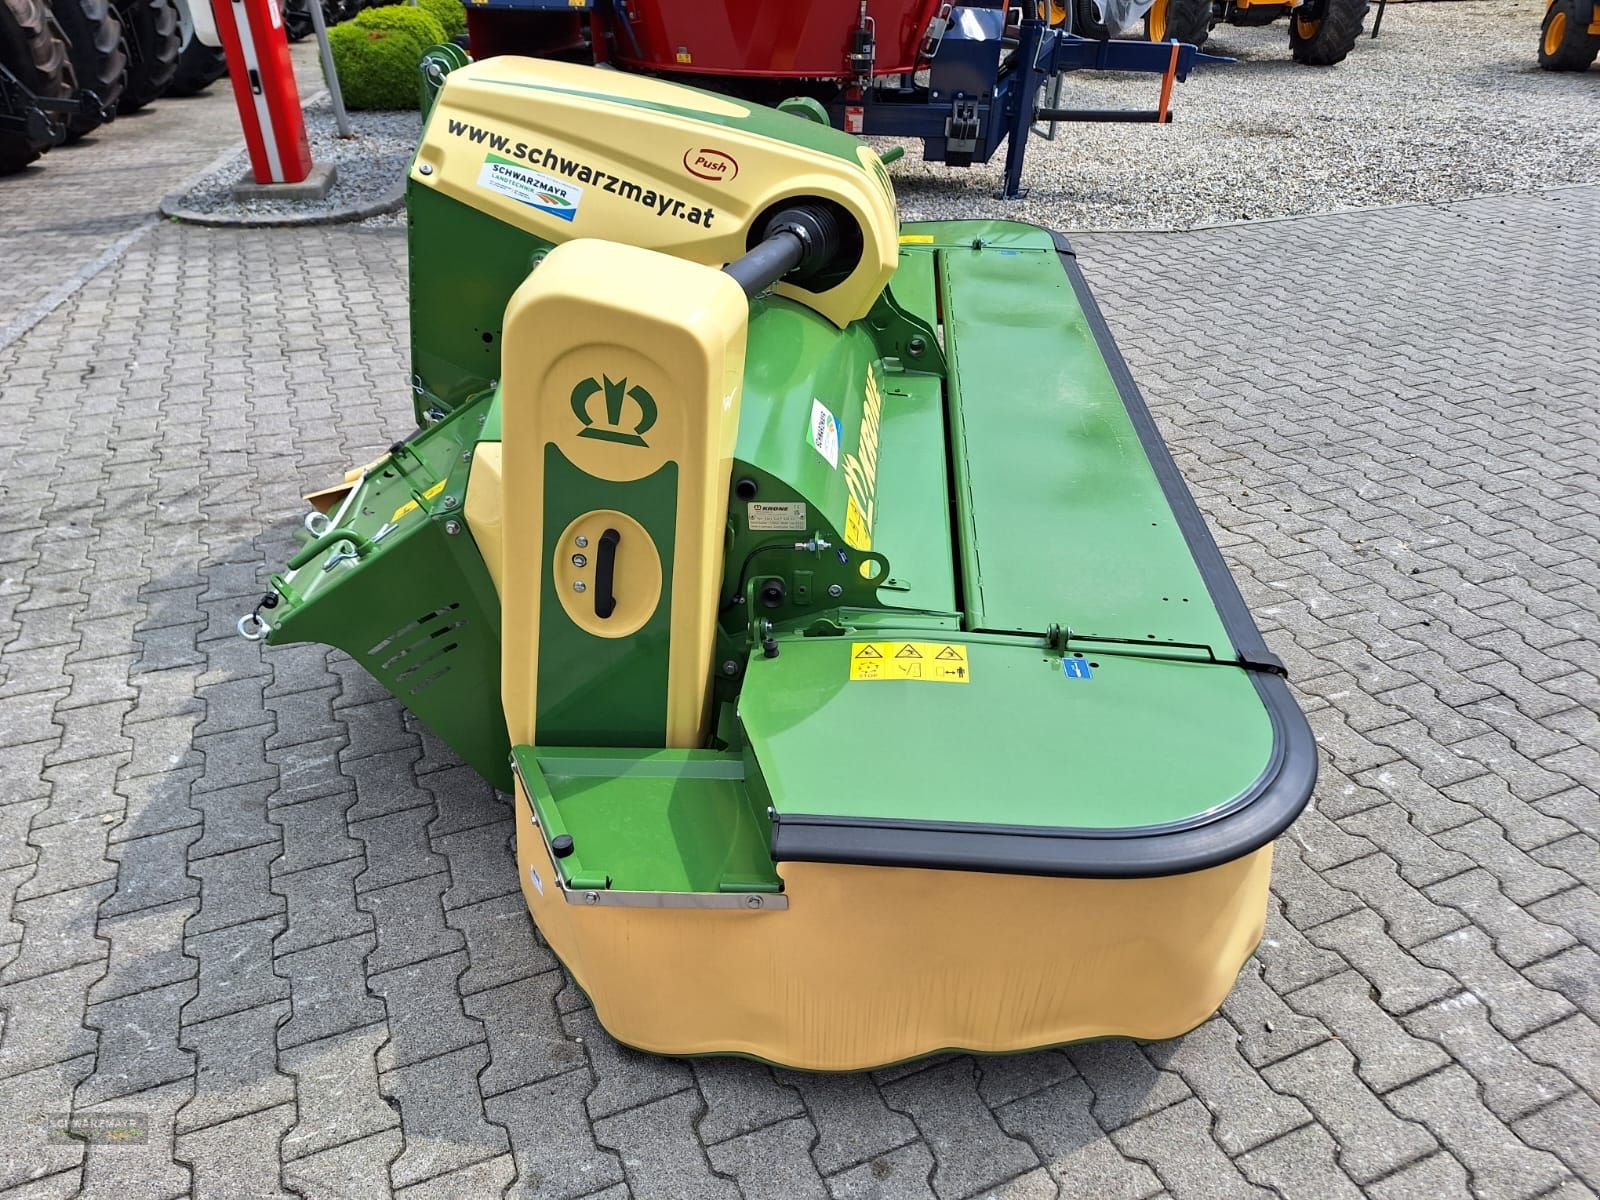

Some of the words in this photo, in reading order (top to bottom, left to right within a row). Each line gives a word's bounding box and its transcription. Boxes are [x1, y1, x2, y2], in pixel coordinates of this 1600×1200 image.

[448, 119, 715, 228] www.schwarzmayr.at
[694, 156, 727, 172] Push
[491, 173, 535, 193] LANDTECHNIK
[492, 164, 567, 198] SCHWARZMAYR
